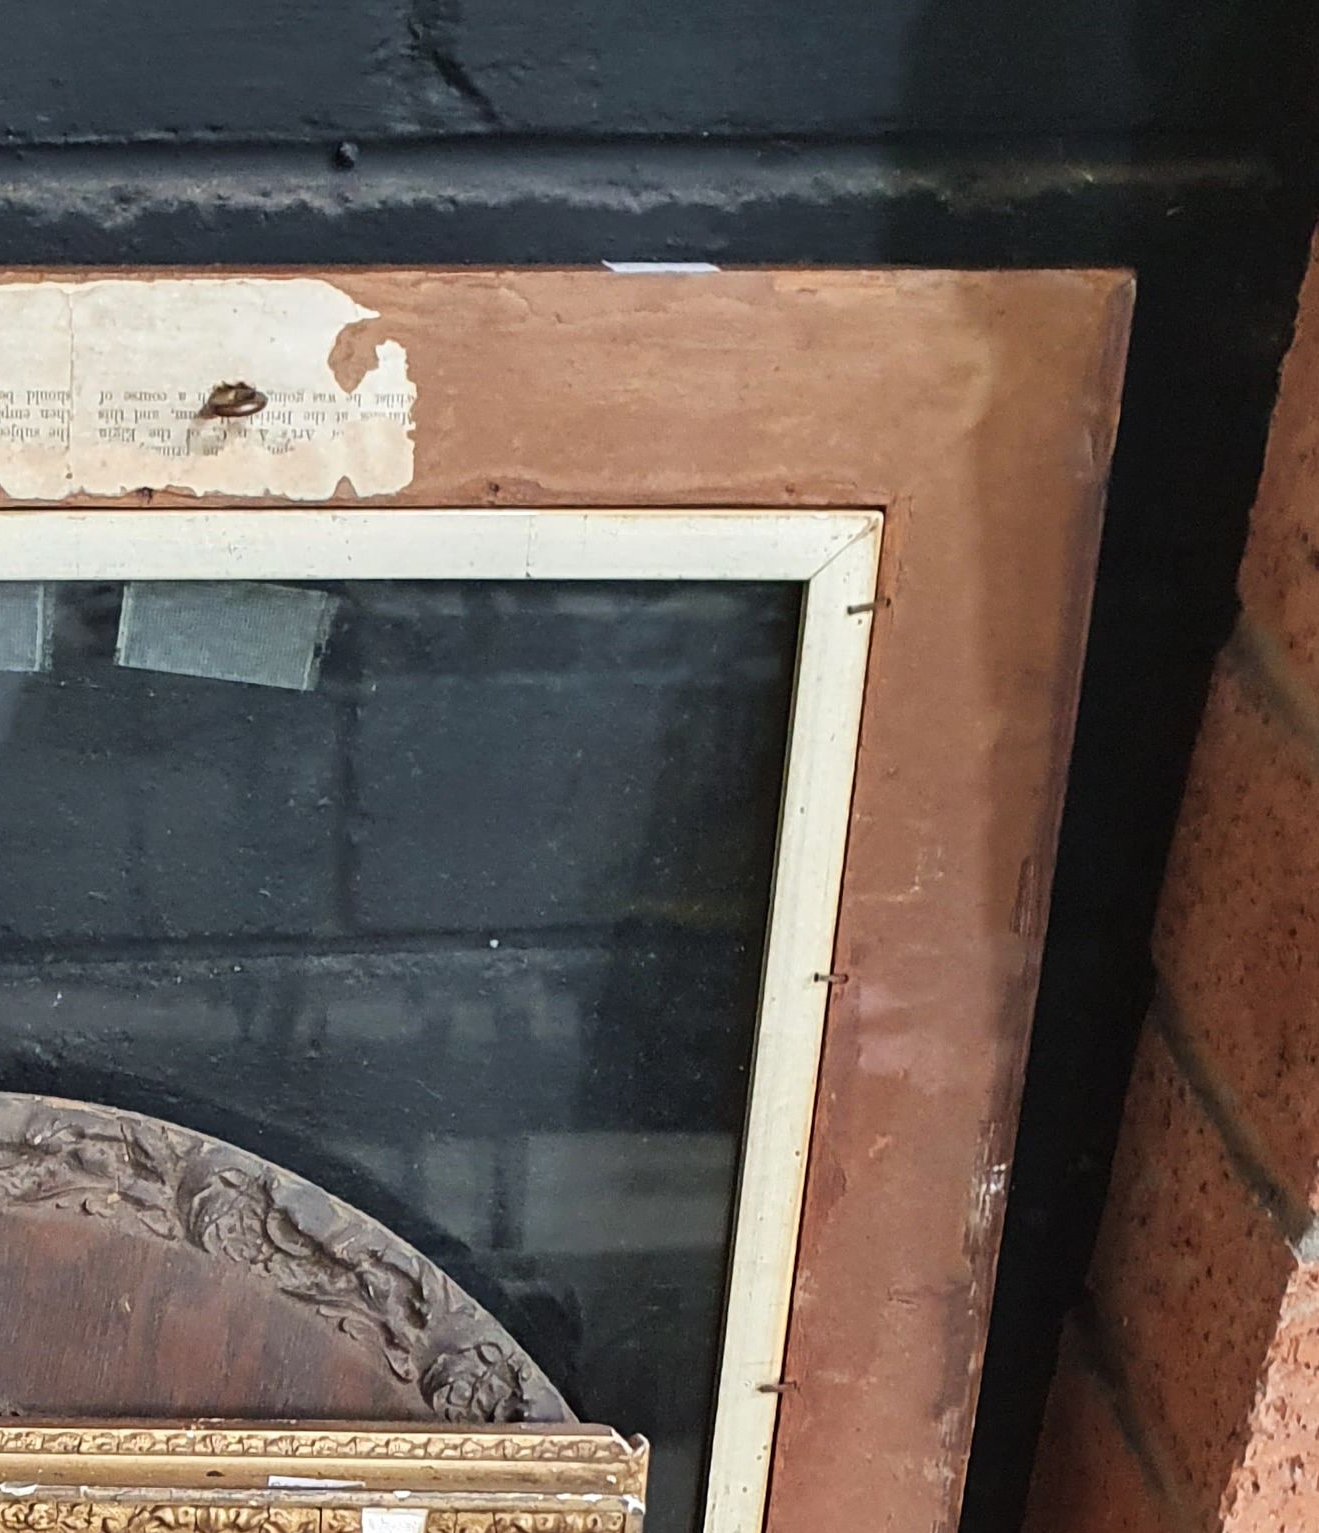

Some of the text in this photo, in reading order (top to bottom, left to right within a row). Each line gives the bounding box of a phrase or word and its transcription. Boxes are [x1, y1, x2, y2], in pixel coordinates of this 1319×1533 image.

[26, 390, 71, 406] should
[98, 391, 113, 405] of
[124, 391, 167, 401] course
[178, 392, 186, 401] a
[266, 390, 304, 407] going
[312, 392, 336, 403] was
[345, 393, 361, 408] he
[39, 409, 70, 424] then
[98, 409, 124, 424] this
[134, 409, 159, 424] and
[304, 412, 325, 425] the
[336, 412, 349, 423] at
[99, 427, 135, 442] Elgin
[149, 428, 171, 443] the
